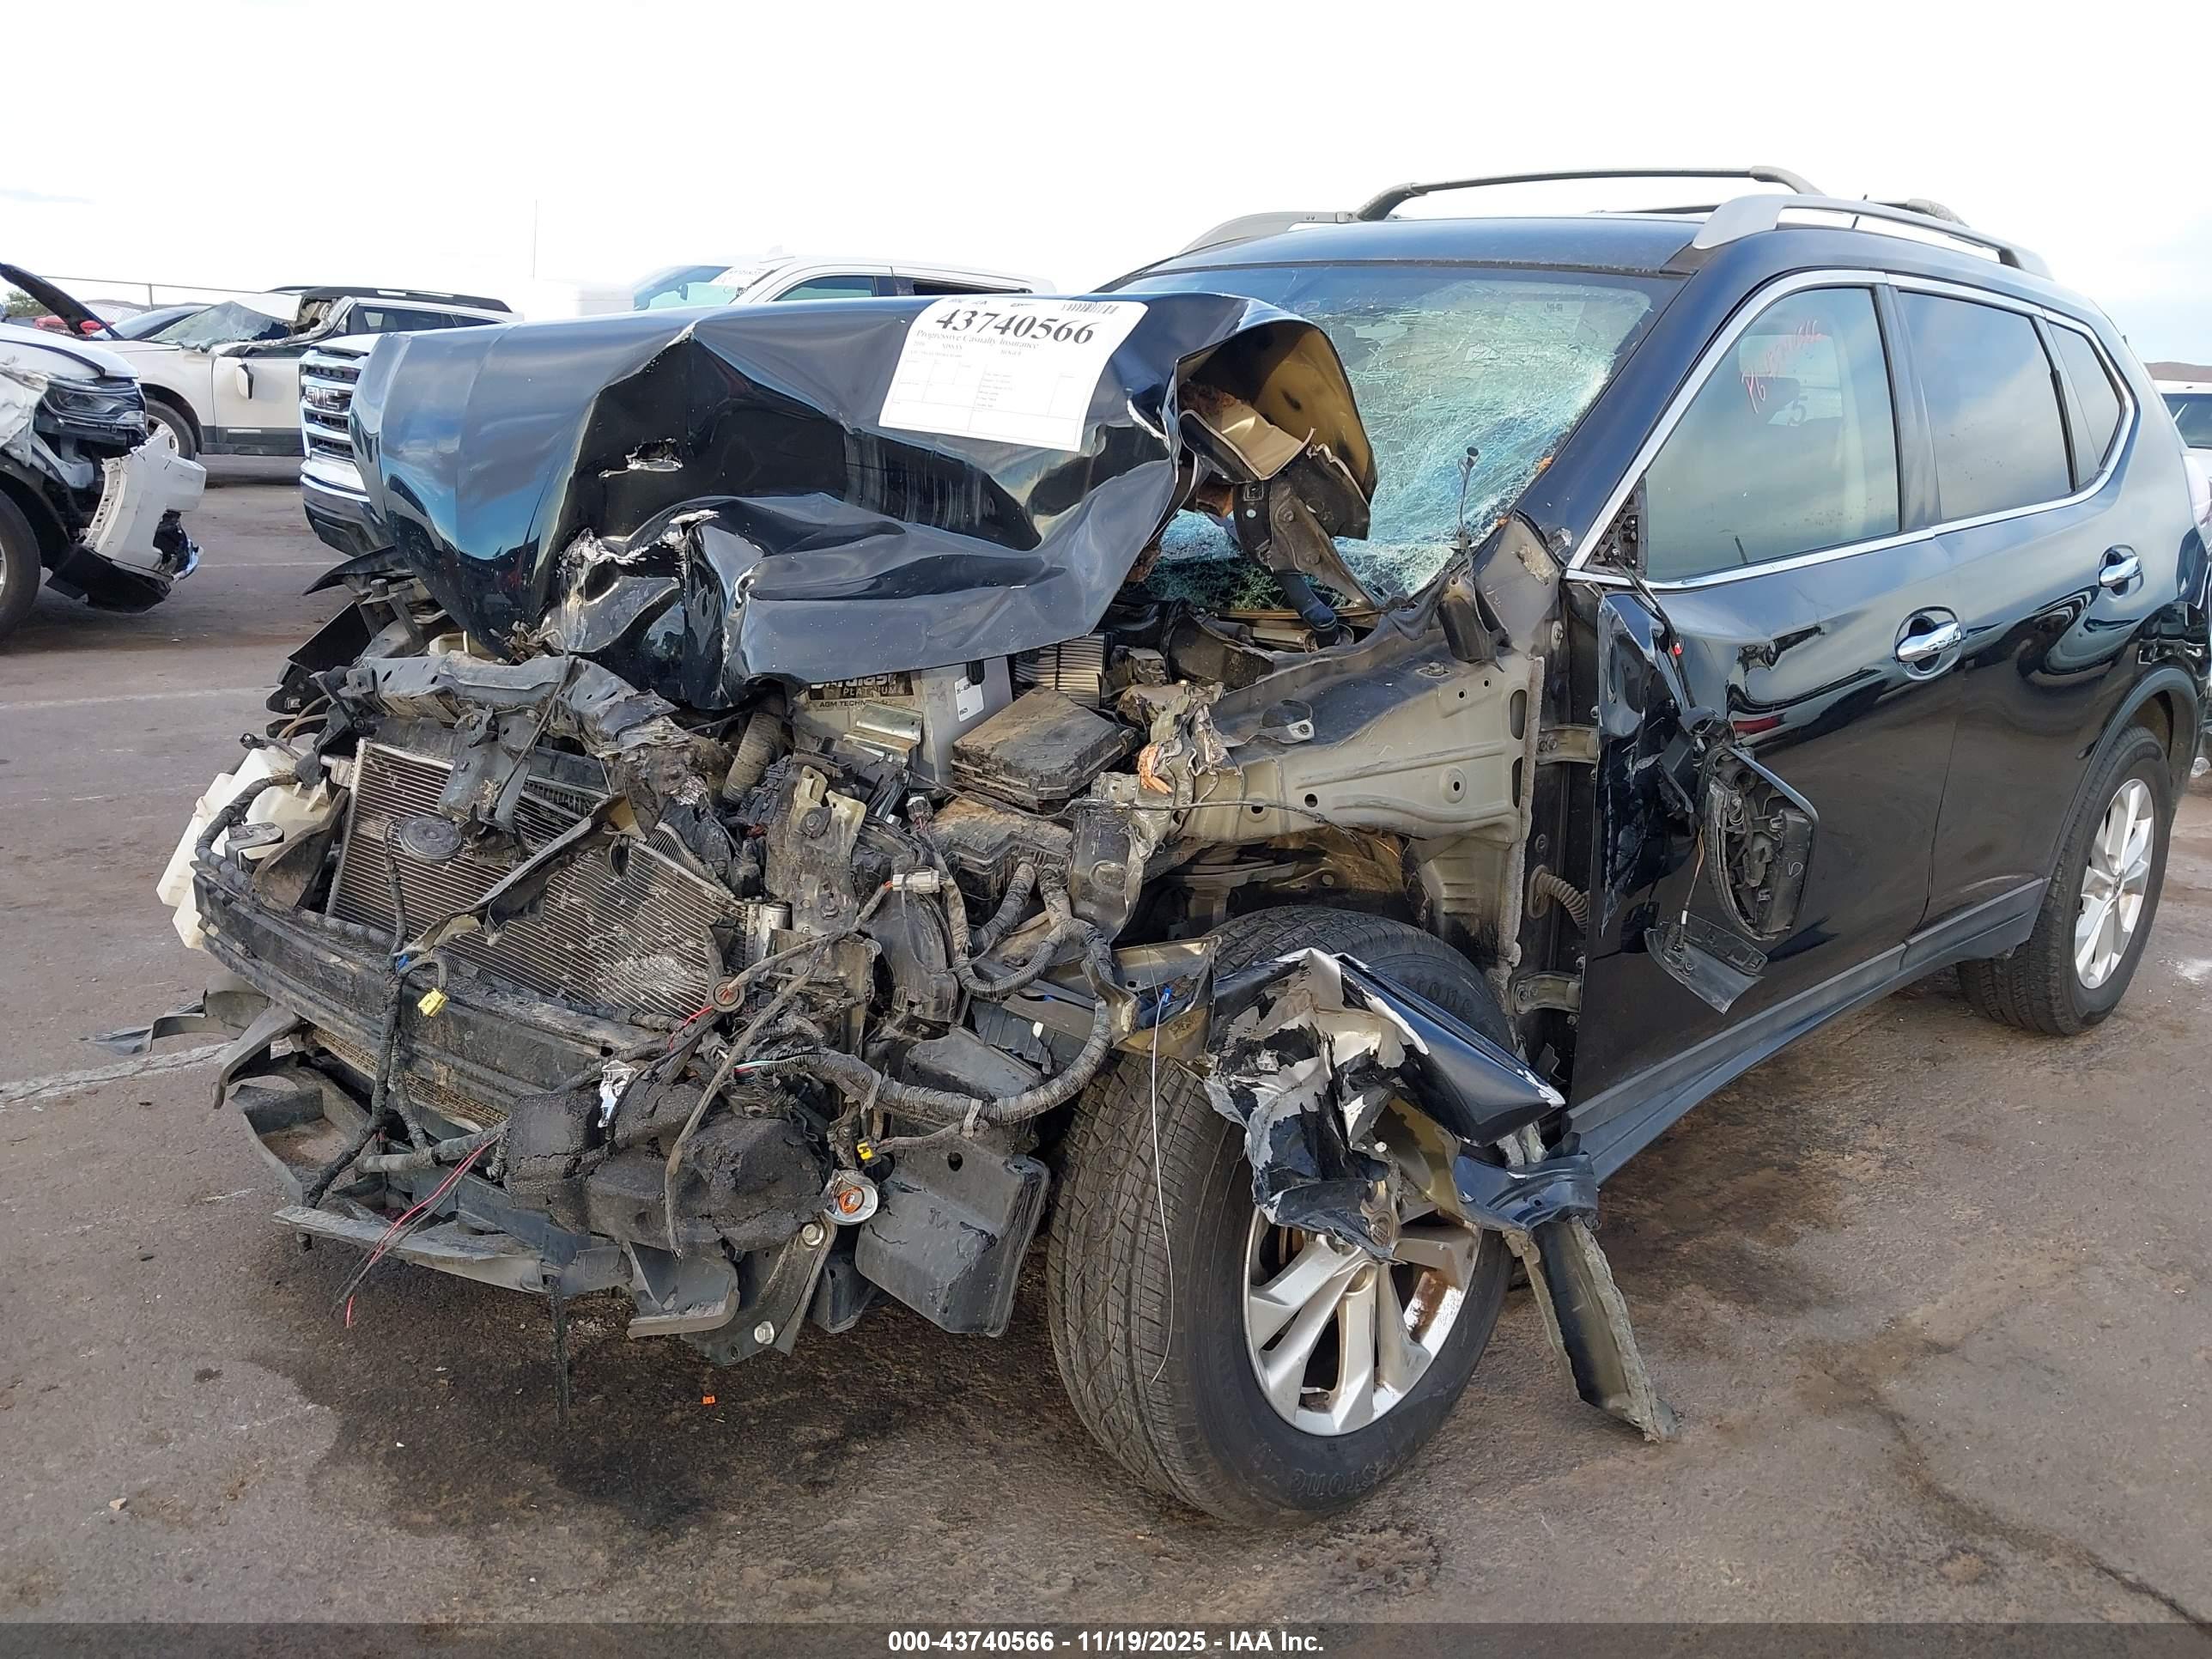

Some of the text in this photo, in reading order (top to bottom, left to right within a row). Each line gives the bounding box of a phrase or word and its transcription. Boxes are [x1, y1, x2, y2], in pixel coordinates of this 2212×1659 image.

[935, 308, 1102, 344] 43740566
[916, 329, 1039, 349] Progressive Casualty Insurance
[305, 386, 340, 410] GMC
